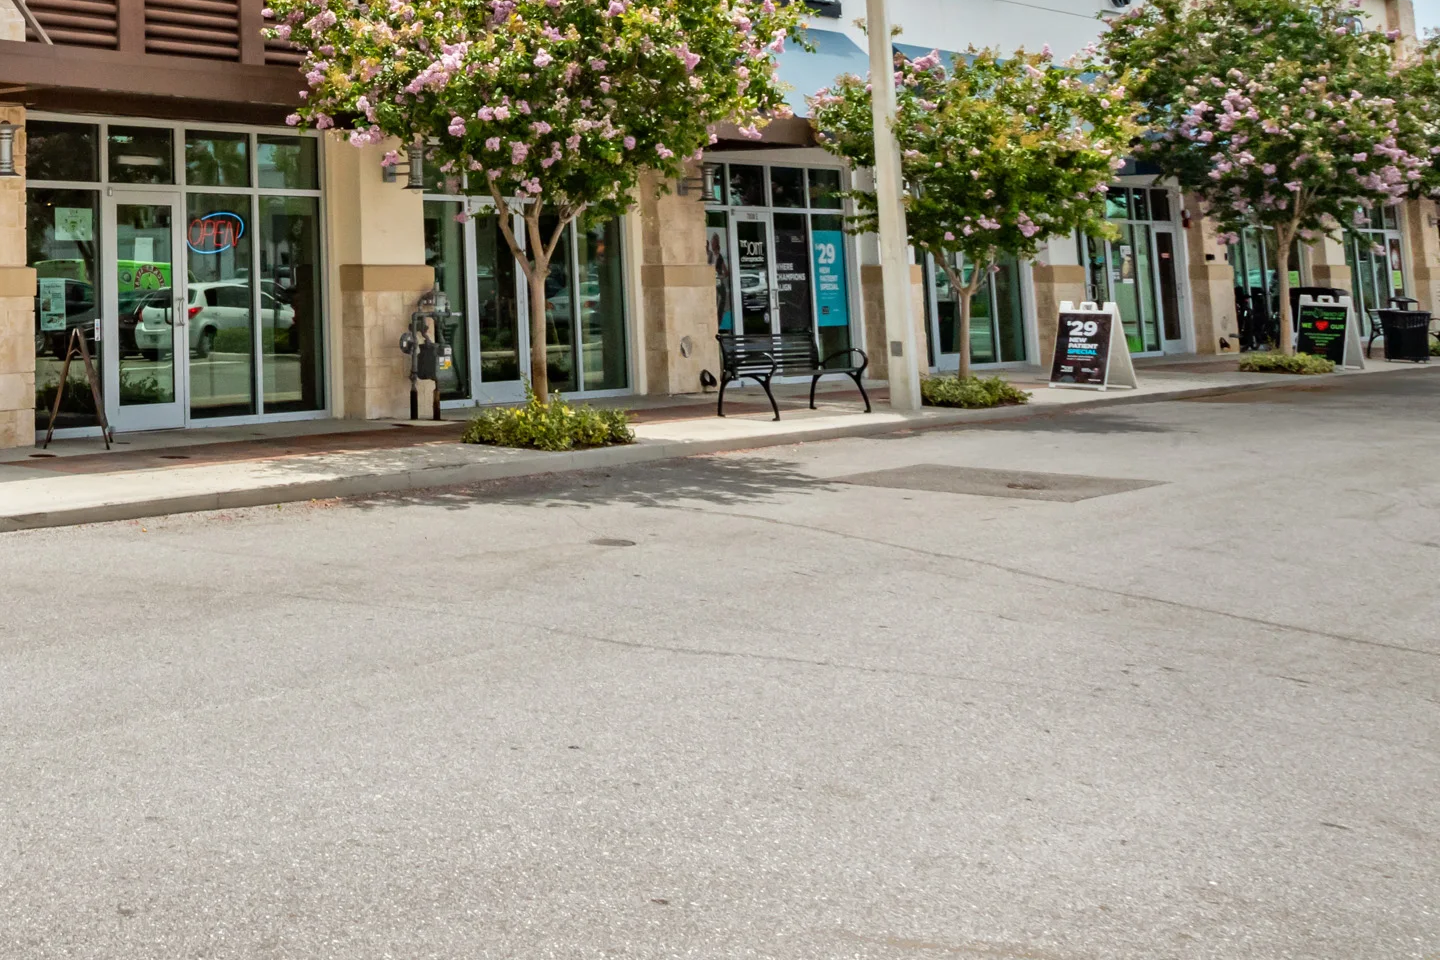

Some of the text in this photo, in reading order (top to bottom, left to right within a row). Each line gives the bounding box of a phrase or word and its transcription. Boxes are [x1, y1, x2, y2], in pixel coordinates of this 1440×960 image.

[187, 218, 241, 247] OPEN
[1066, 320, 1099, 337] $29
[1067, 342, 1099, 350] PATIENT
